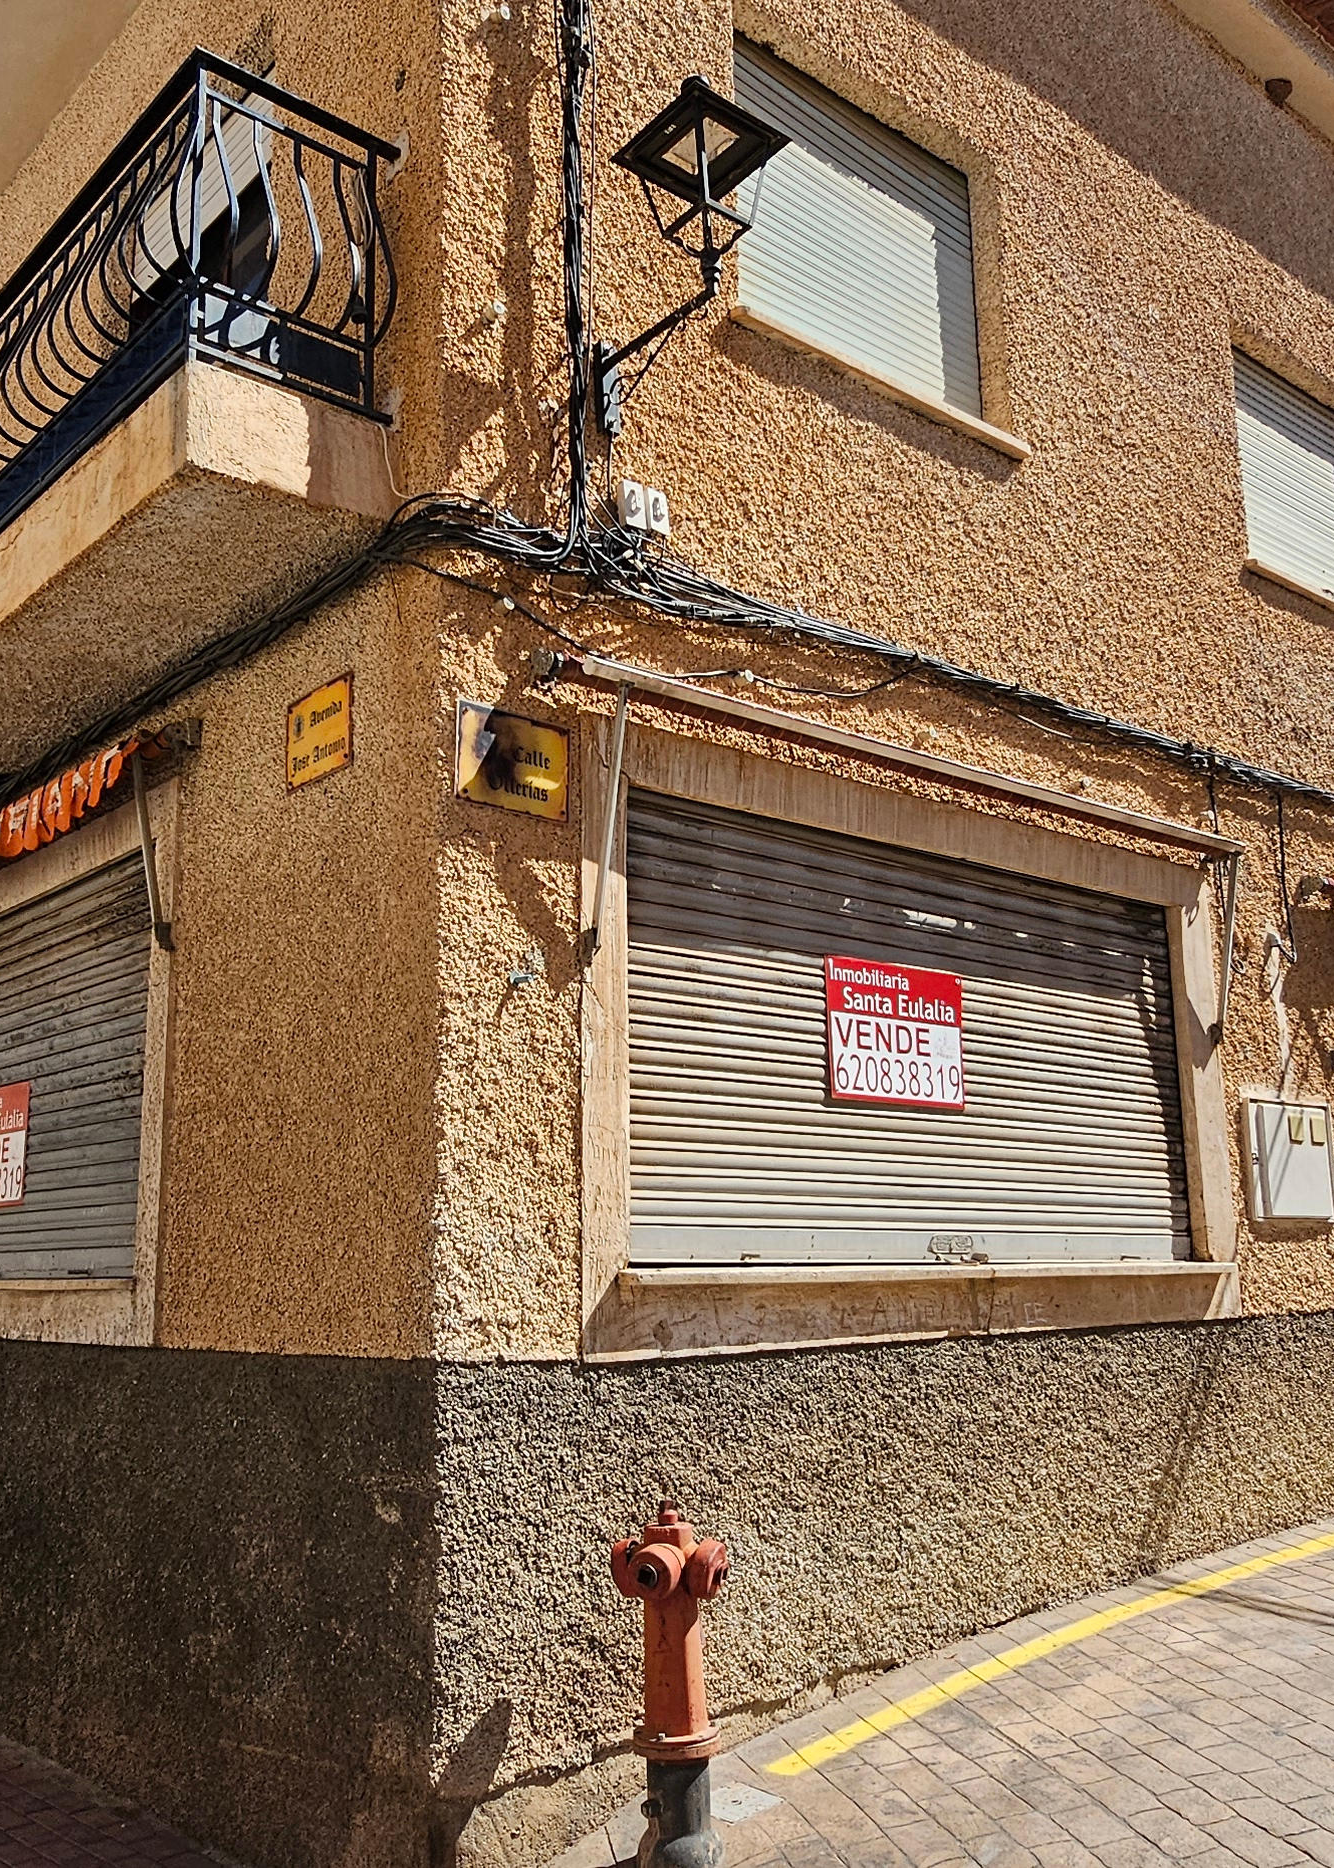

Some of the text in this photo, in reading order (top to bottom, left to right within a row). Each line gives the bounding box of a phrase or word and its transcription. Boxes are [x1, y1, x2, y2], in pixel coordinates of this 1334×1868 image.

[313, 737, 346, 763] Antonio
[514, 746, 551, 770] Calle
[828, 959, 910, 991] Inmobiliaria
[843, 987, 955, 1023] Santa Eulalia
[834, 1017, 931, 1057] VENDE
[835, 1053, 960, 1100] 620838319
